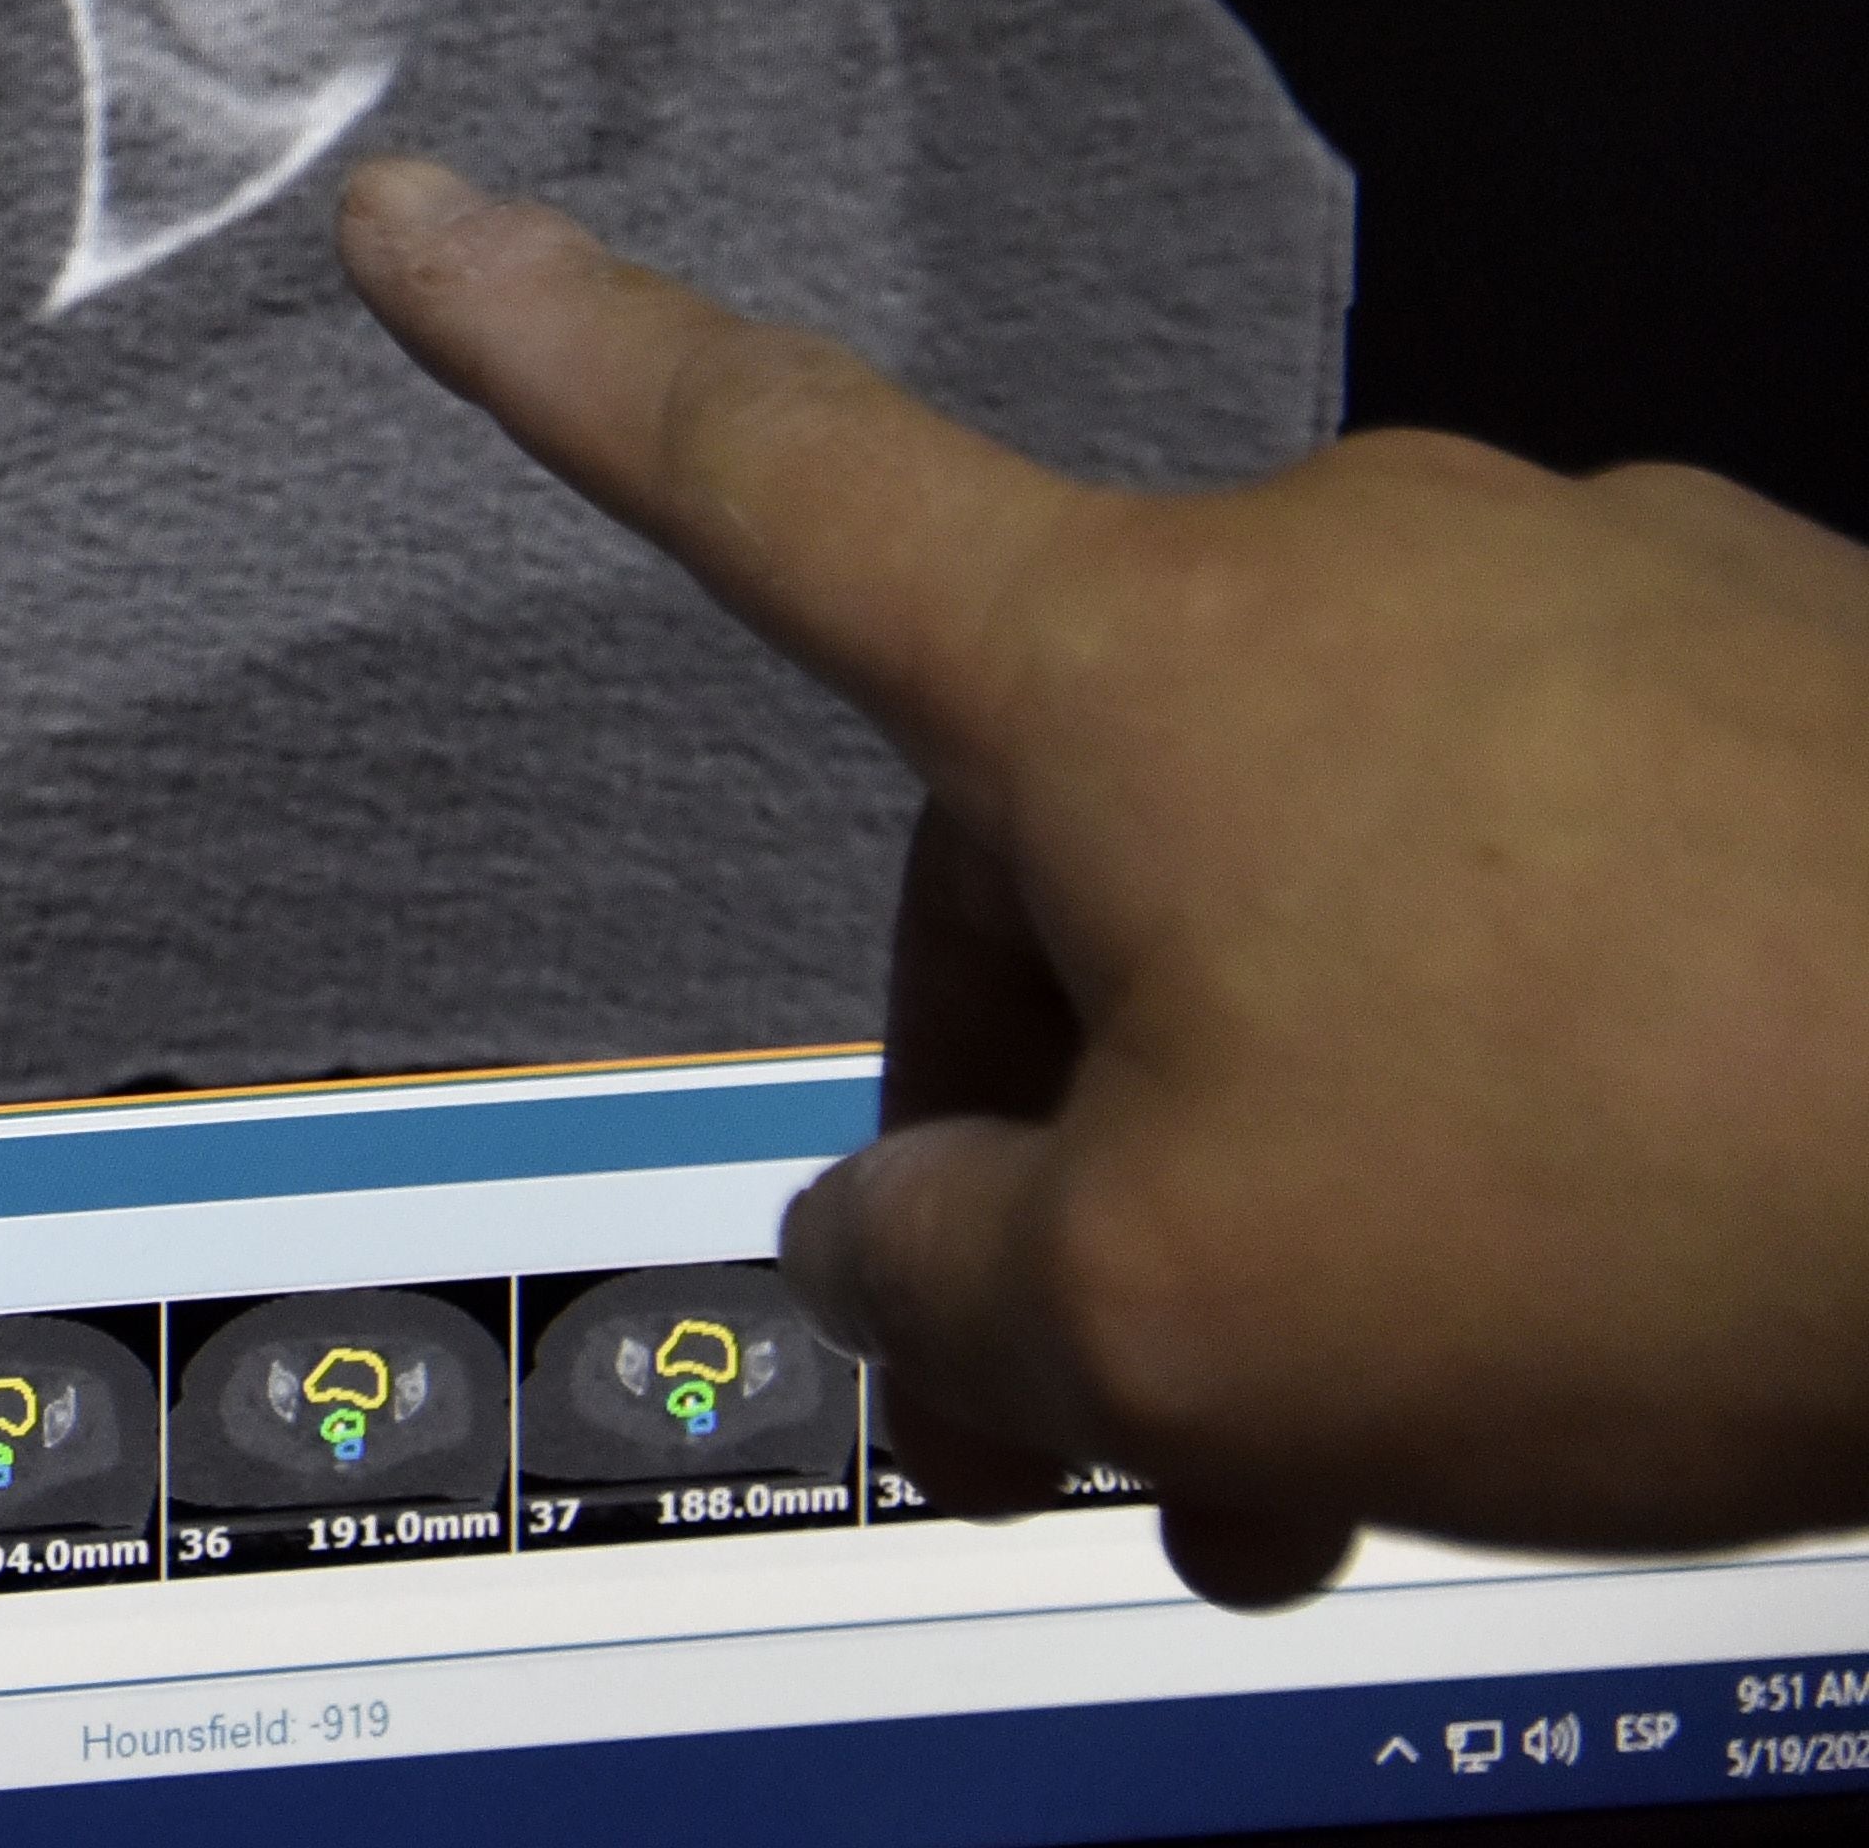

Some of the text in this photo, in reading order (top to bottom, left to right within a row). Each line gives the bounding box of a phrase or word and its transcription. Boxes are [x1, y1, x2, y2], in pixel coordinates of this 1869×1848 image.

[177, 1506, 501, 1563] 36 191.0mm
[527, 1481, 849, 1535] 37 188.0mm
[1735, 1673, 1804, 1714] 9:51
[81, 1700, 390, 1762] Hounsfield: -919
[1615, 1711, 1680, 1753] ESP
